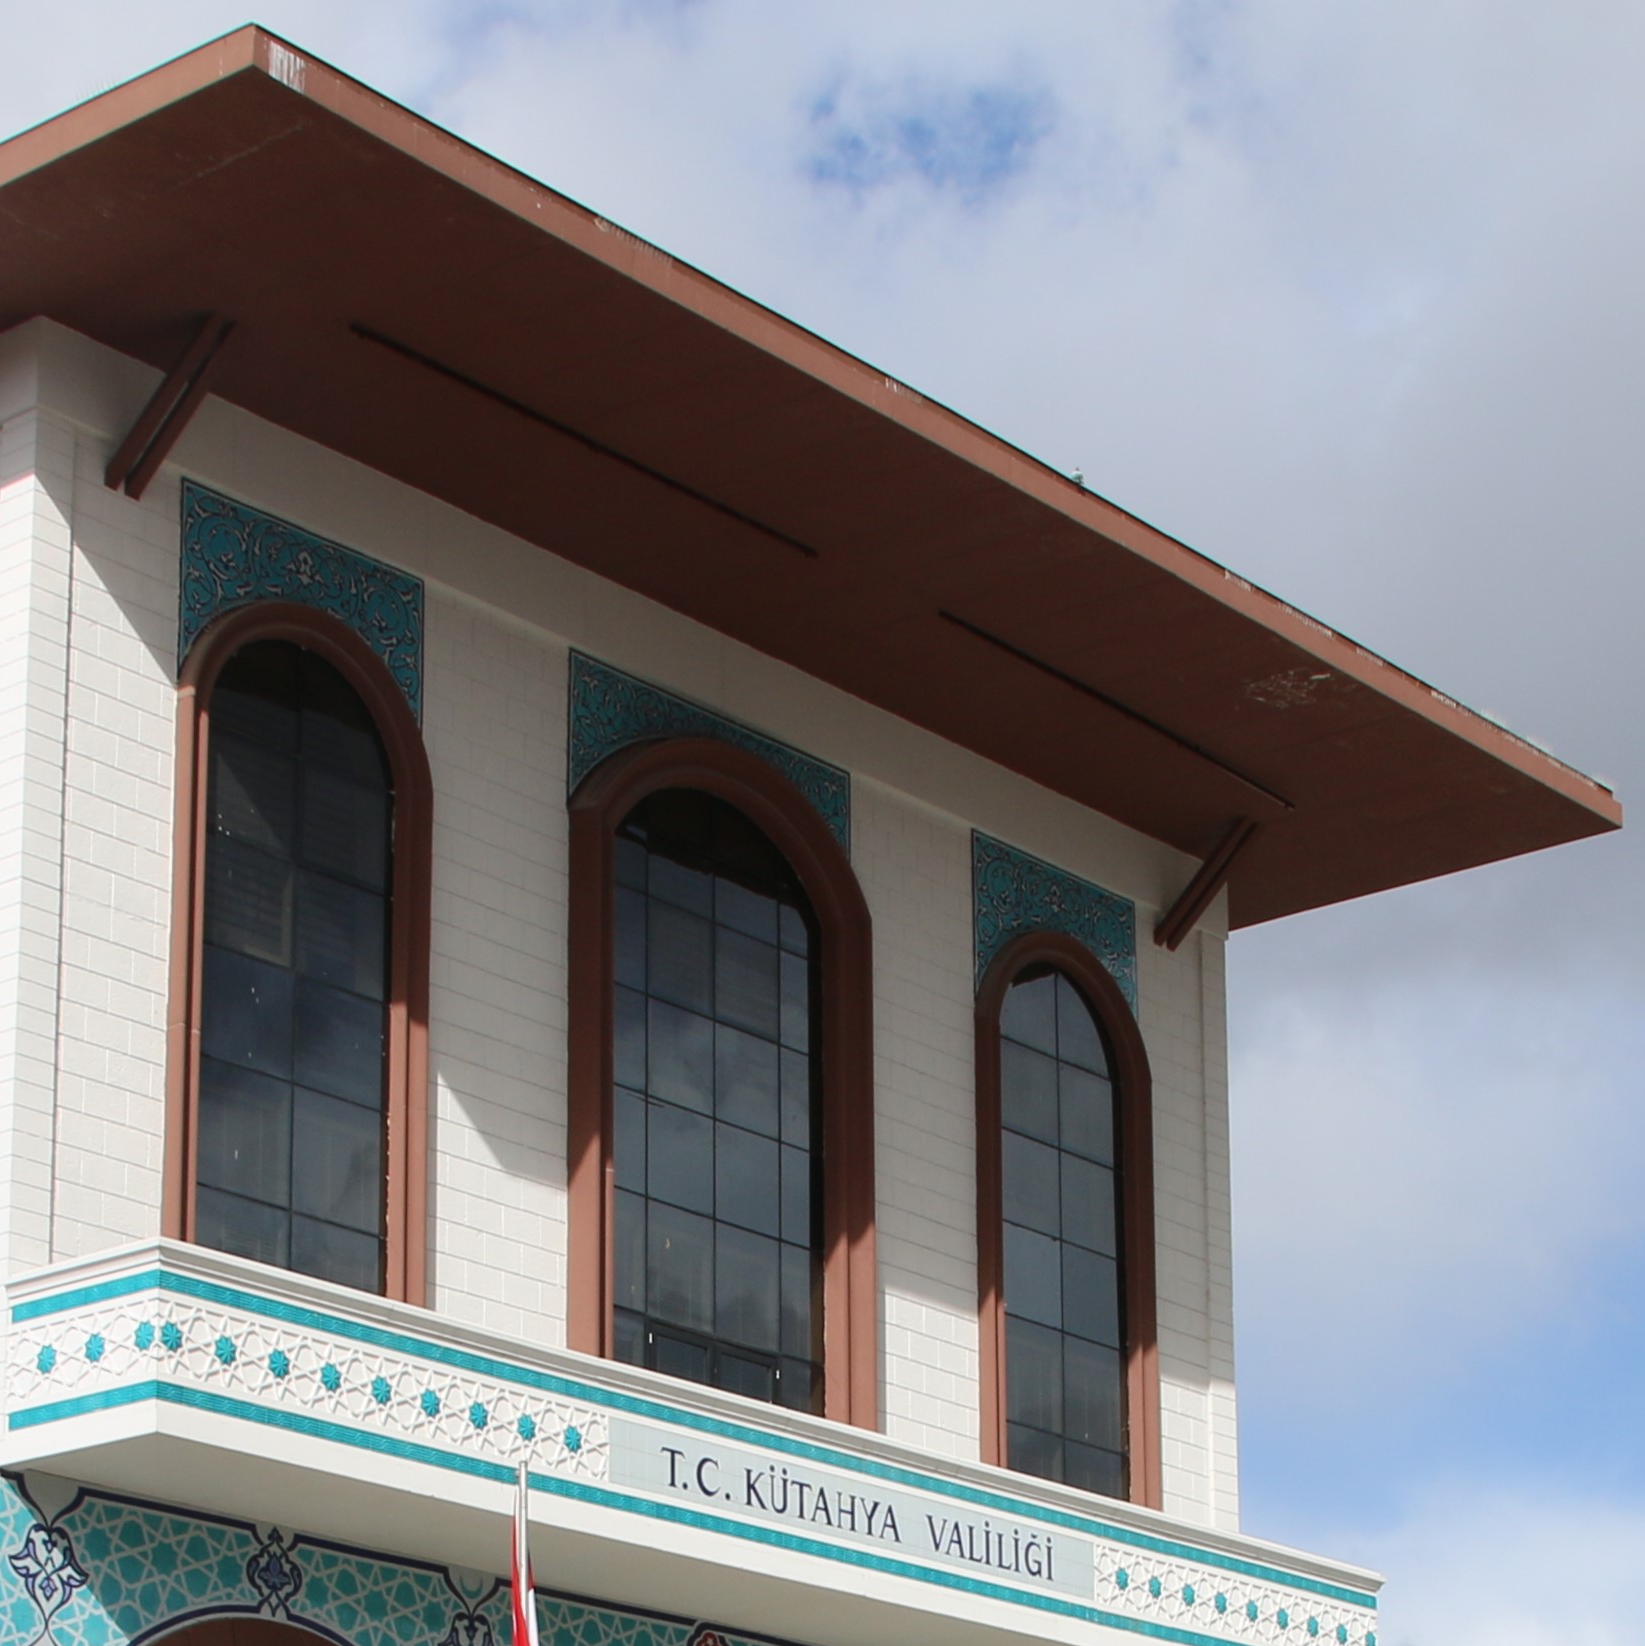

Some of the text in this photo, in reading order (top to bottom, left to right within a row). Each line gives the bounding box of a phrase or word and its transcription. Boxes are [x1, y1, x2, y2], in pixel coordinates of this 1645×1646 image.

[659, 1446, 1056, 1581] T.C. KÜTAHYA VALİLİĞİ
